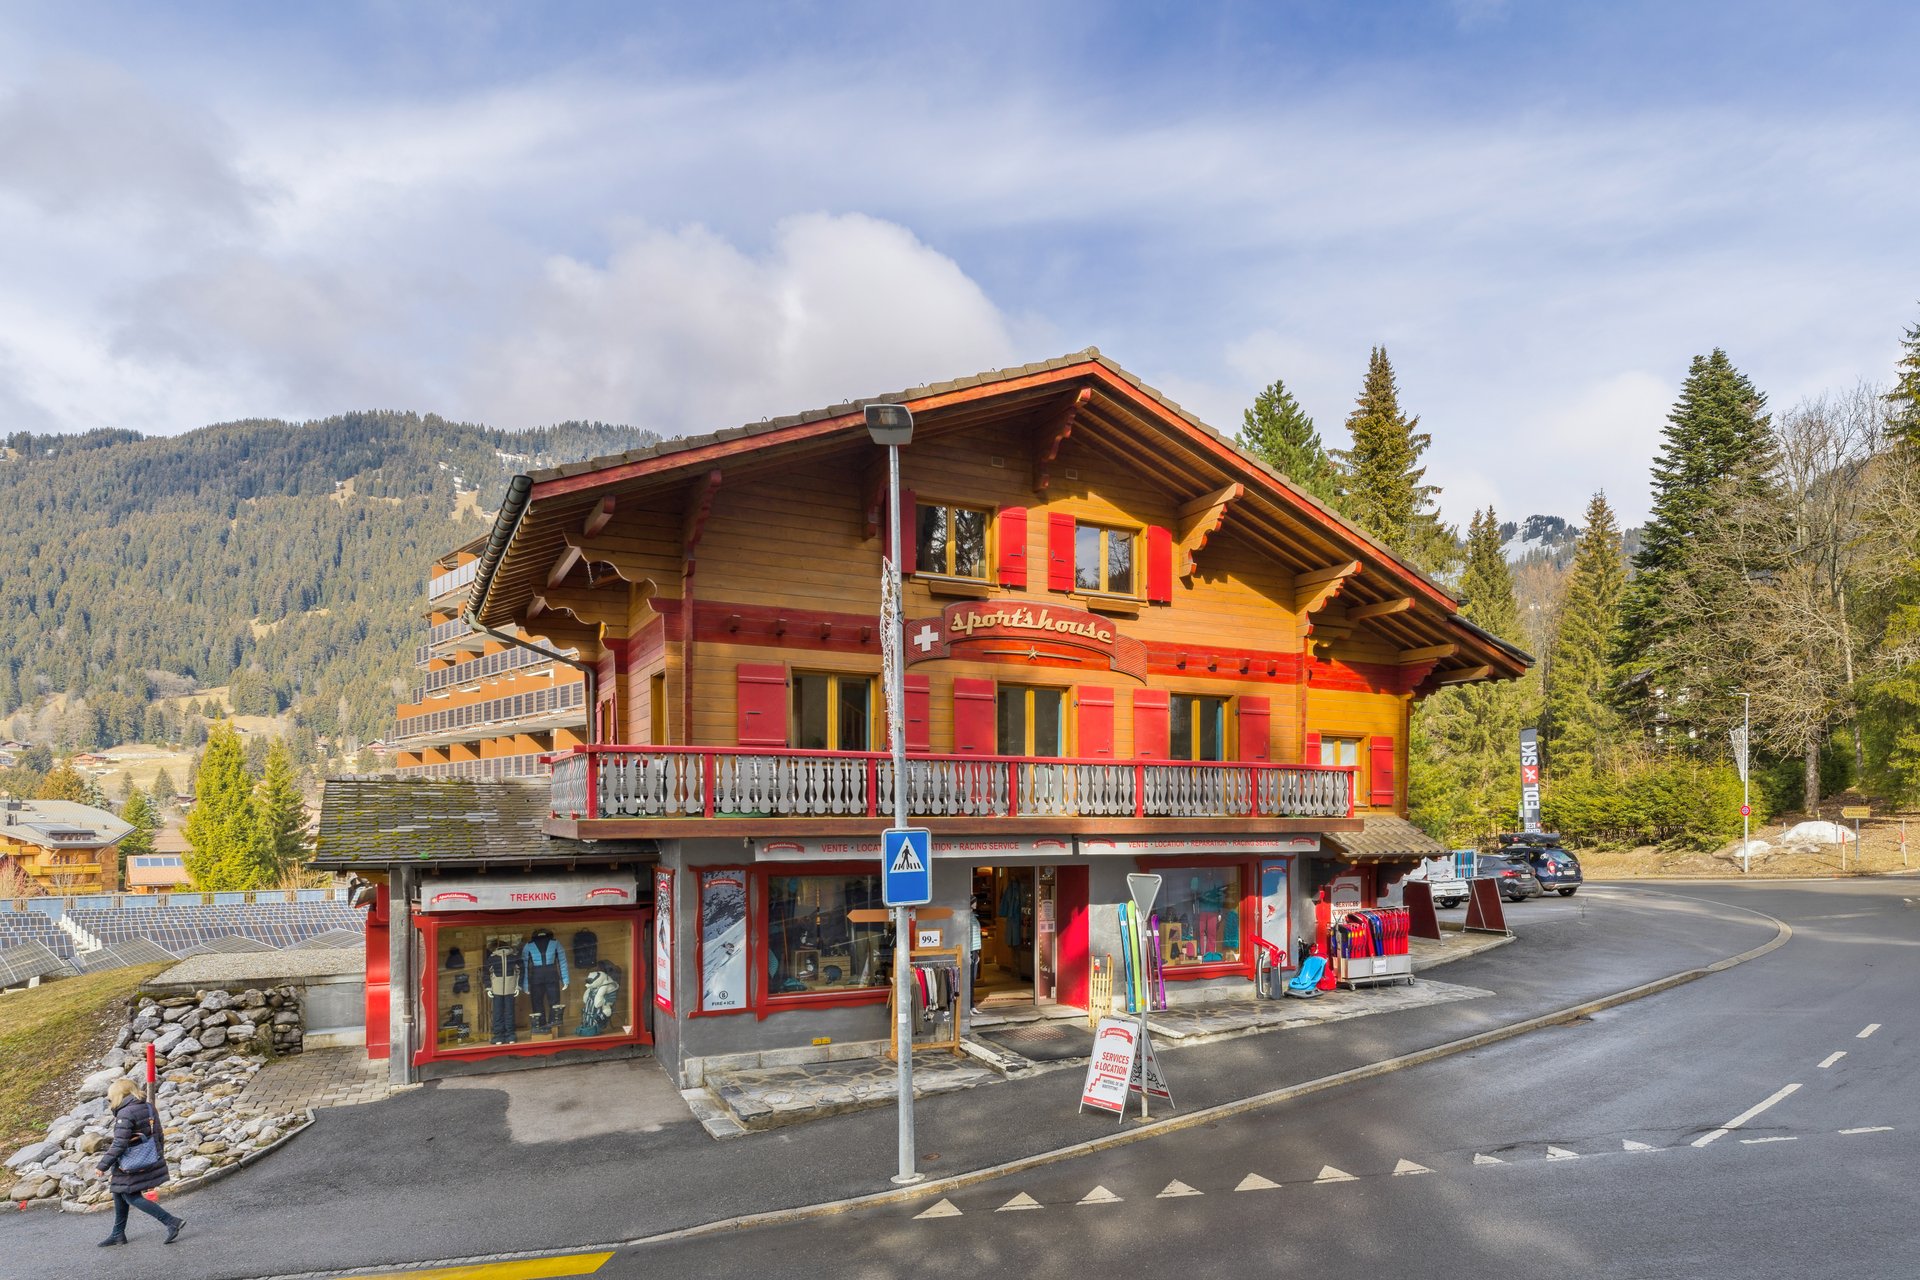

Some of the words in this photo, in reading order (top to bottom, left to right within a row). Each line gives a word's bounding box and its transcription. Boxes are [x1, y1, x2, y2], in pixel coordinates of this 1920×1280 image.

[1521, 741, 1538, 766] SKI
[821, 843, 848, 853] VENTE
[856, 843, 881, 852] LOCAT
[959, 841, 987, 850] RACING
[989, 841, 1019, 850] SERVICE
[1155, 840, 1185, 848] LOCATION
[510, 892, 557, 902] TREKKING
[921, 935, 938, 943] 99.-
[1102, 1051, 1130, 1065] SERVICES
[1094, 1062, 1099, 1070] &
[1099, 1063, 1128, 1076] LOCATION
